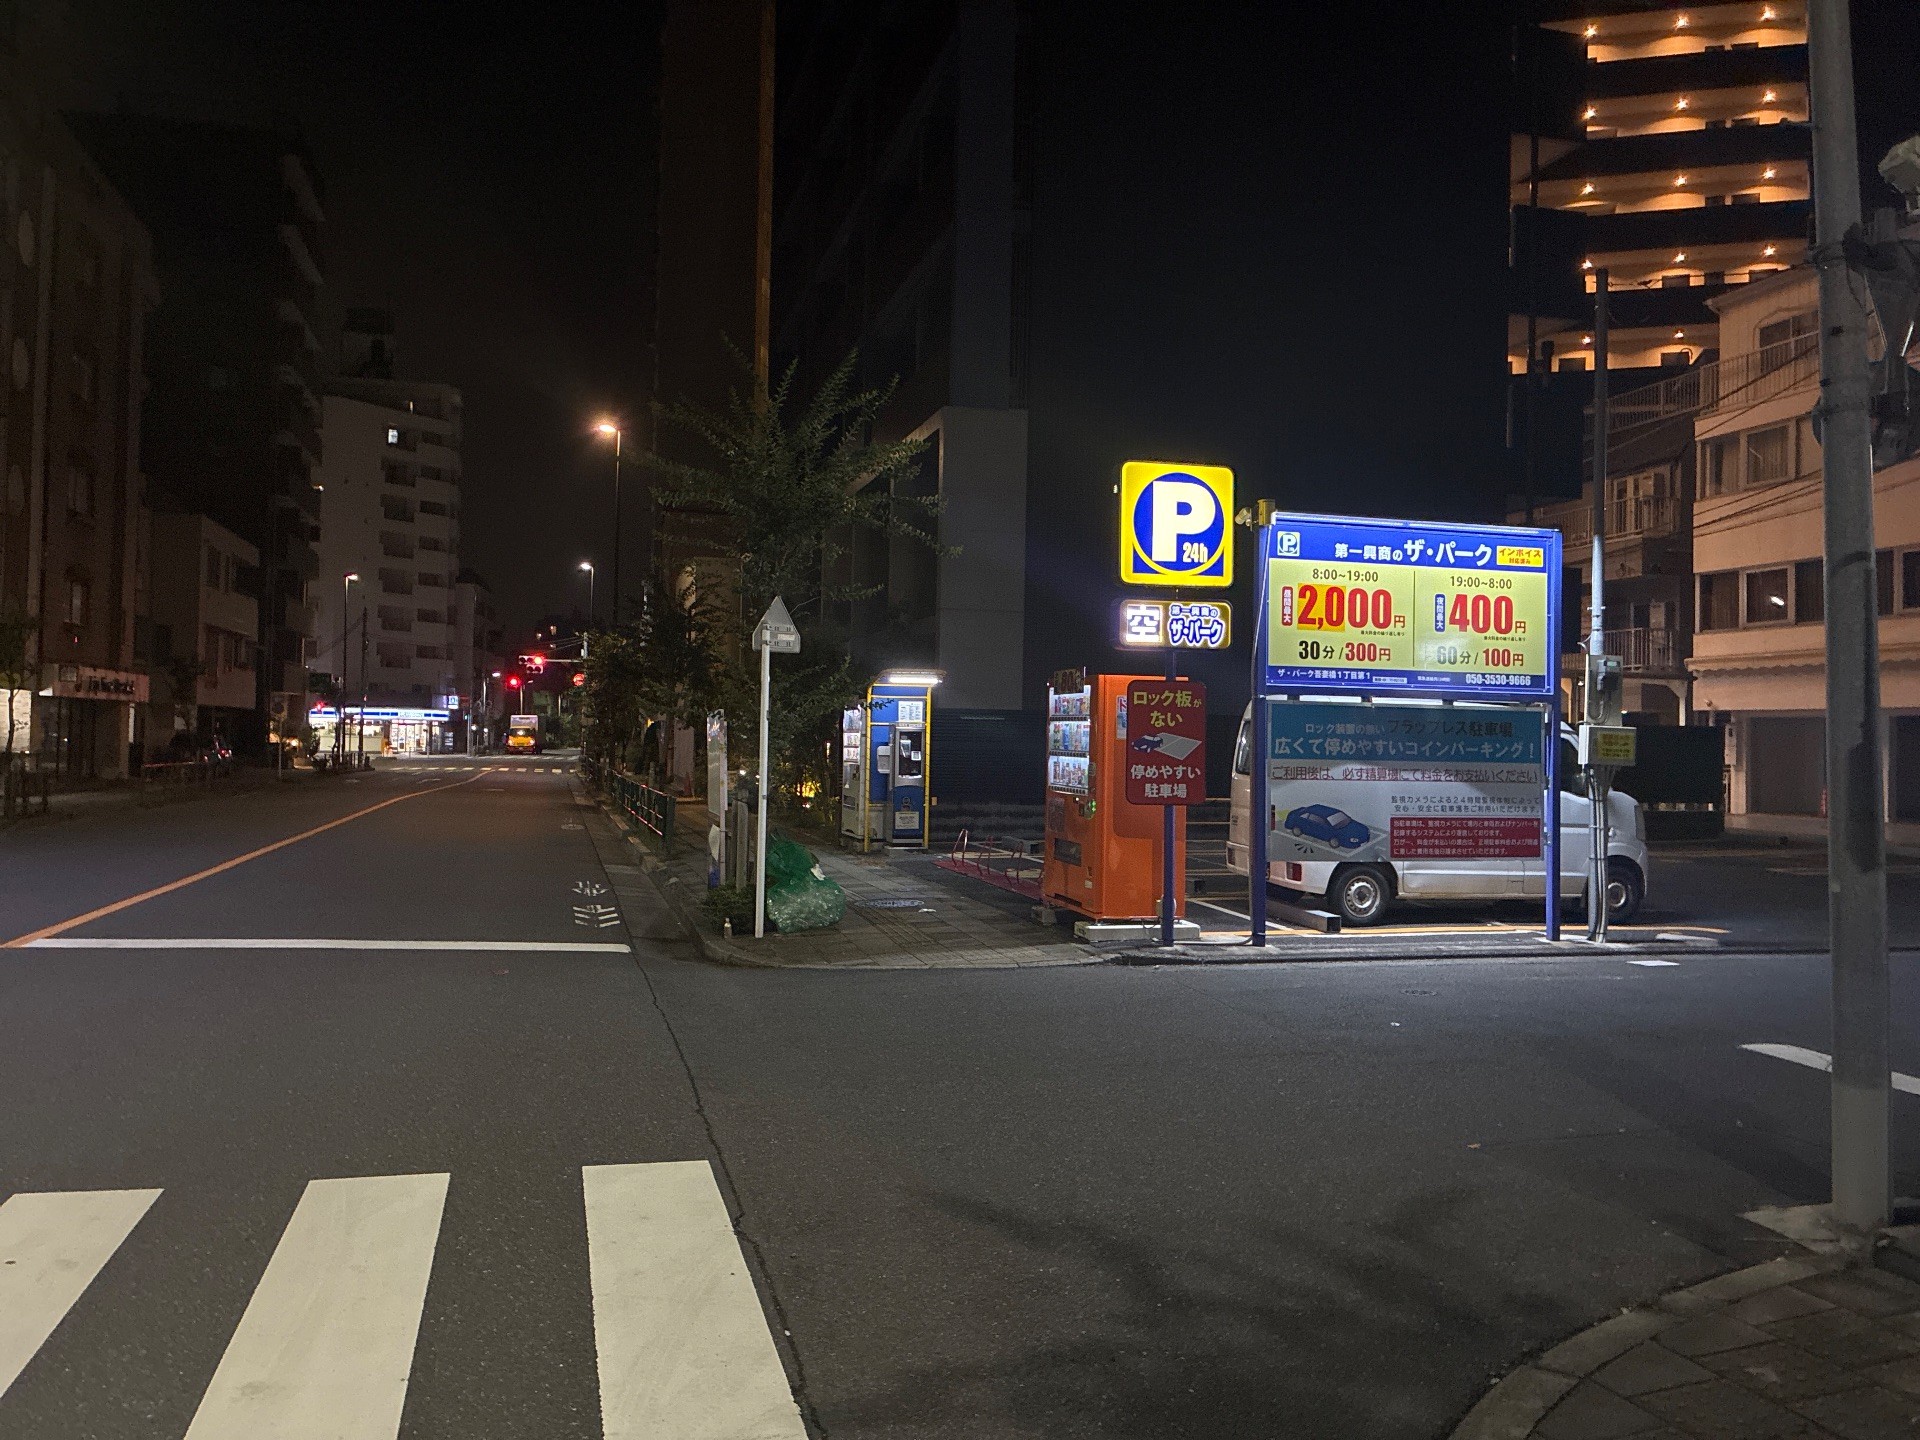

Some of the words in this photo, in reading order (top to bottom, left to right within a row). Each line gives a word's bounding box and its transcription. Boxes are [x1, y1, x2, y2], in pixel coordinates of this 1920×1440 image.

[1152, 481, 1216, 562] P
[1182, 542, 1208, 563] 24h
[1334, 539, 1492, 566] 第一興商のザ・パーク
[1499, 547, 1541, 558] インボイス
[1171, 605, 1218, 618] 第一興商の
[1298, 584, 1405, 630] 2,000円
[1449, 594, 1526, 634] 400円
[1126, 604, 1160, 642] 空
[1170, 618, 1223, 644] ザ・パーク
[1465, 674, 1531, 686] 050-3530-9666
[1133, 690, 1202, 708] ロック板が
[1150, 711, 1182, 727] ない
[1130, 764, 1201, 780] 停めやすい
[1144, 783, 1187, 798] 駐車場
